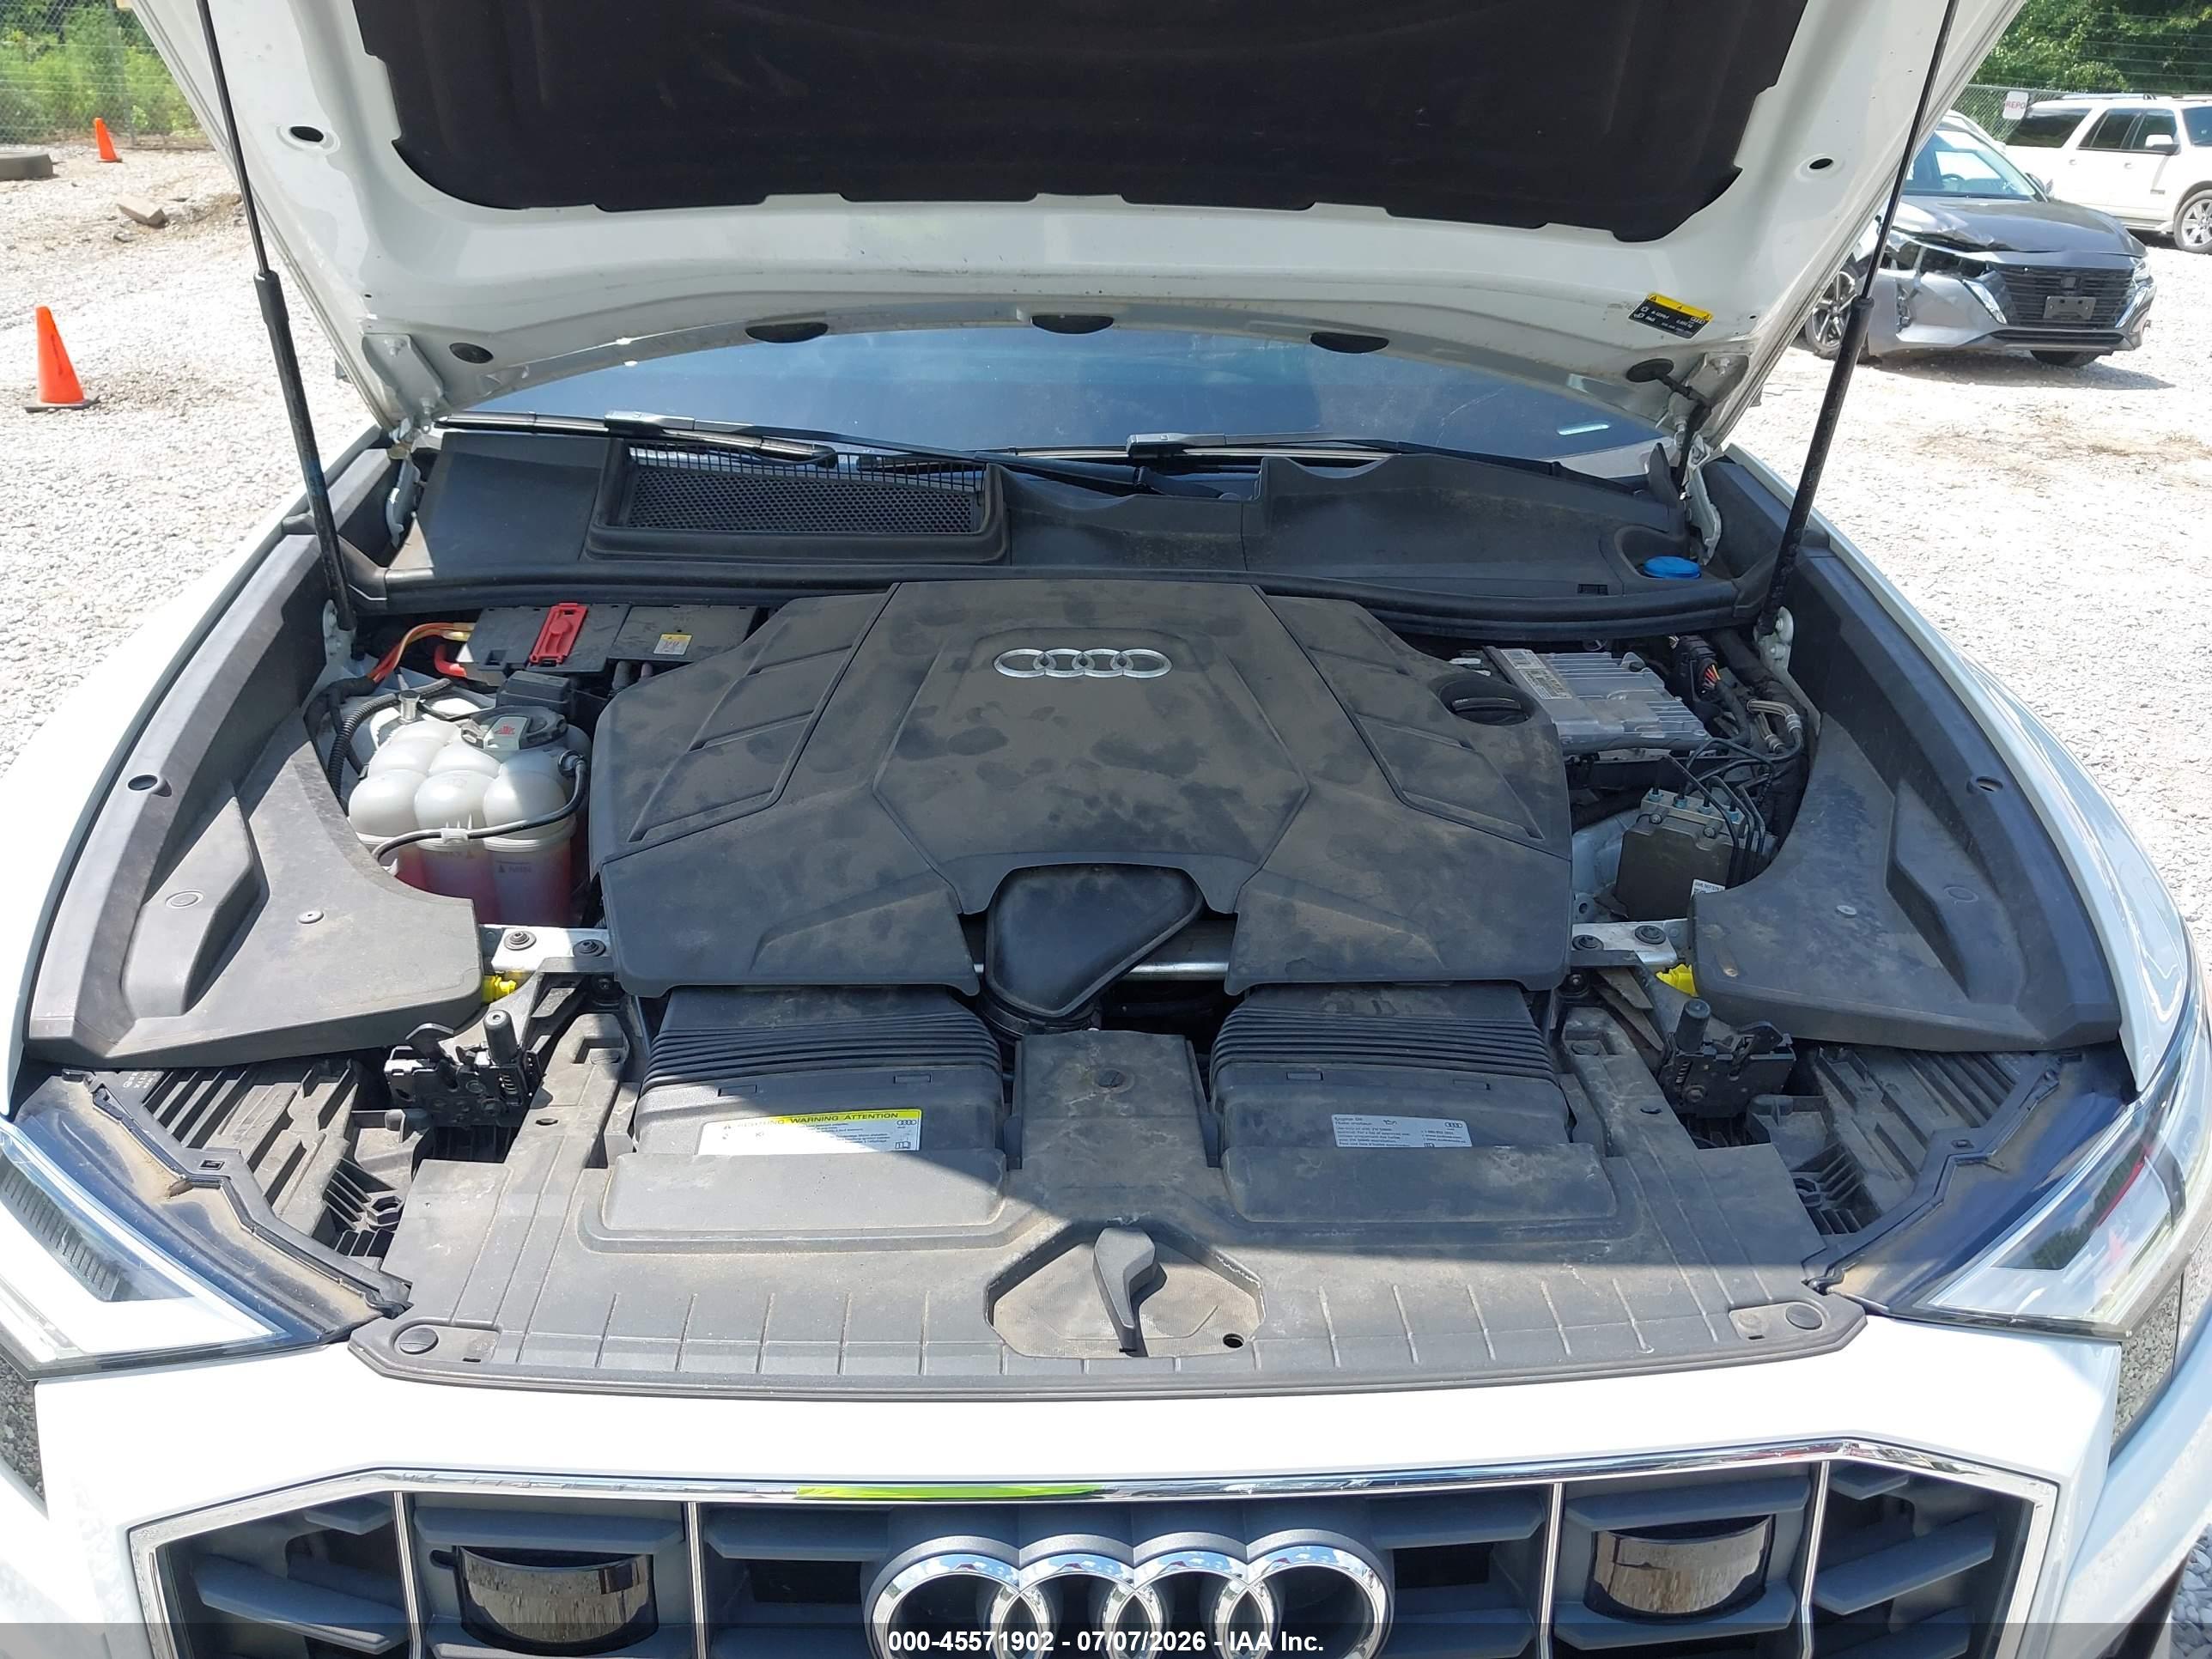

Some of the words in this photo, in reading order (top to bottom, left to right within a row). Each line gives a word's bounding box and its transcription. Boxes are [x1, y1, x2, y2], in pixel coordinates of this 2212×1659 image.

[2006, 100, 2026, 109] REPO
[790, 1115, 839, 1124] WARNING
[844, 1112, 898, 1121] ATTENTION
